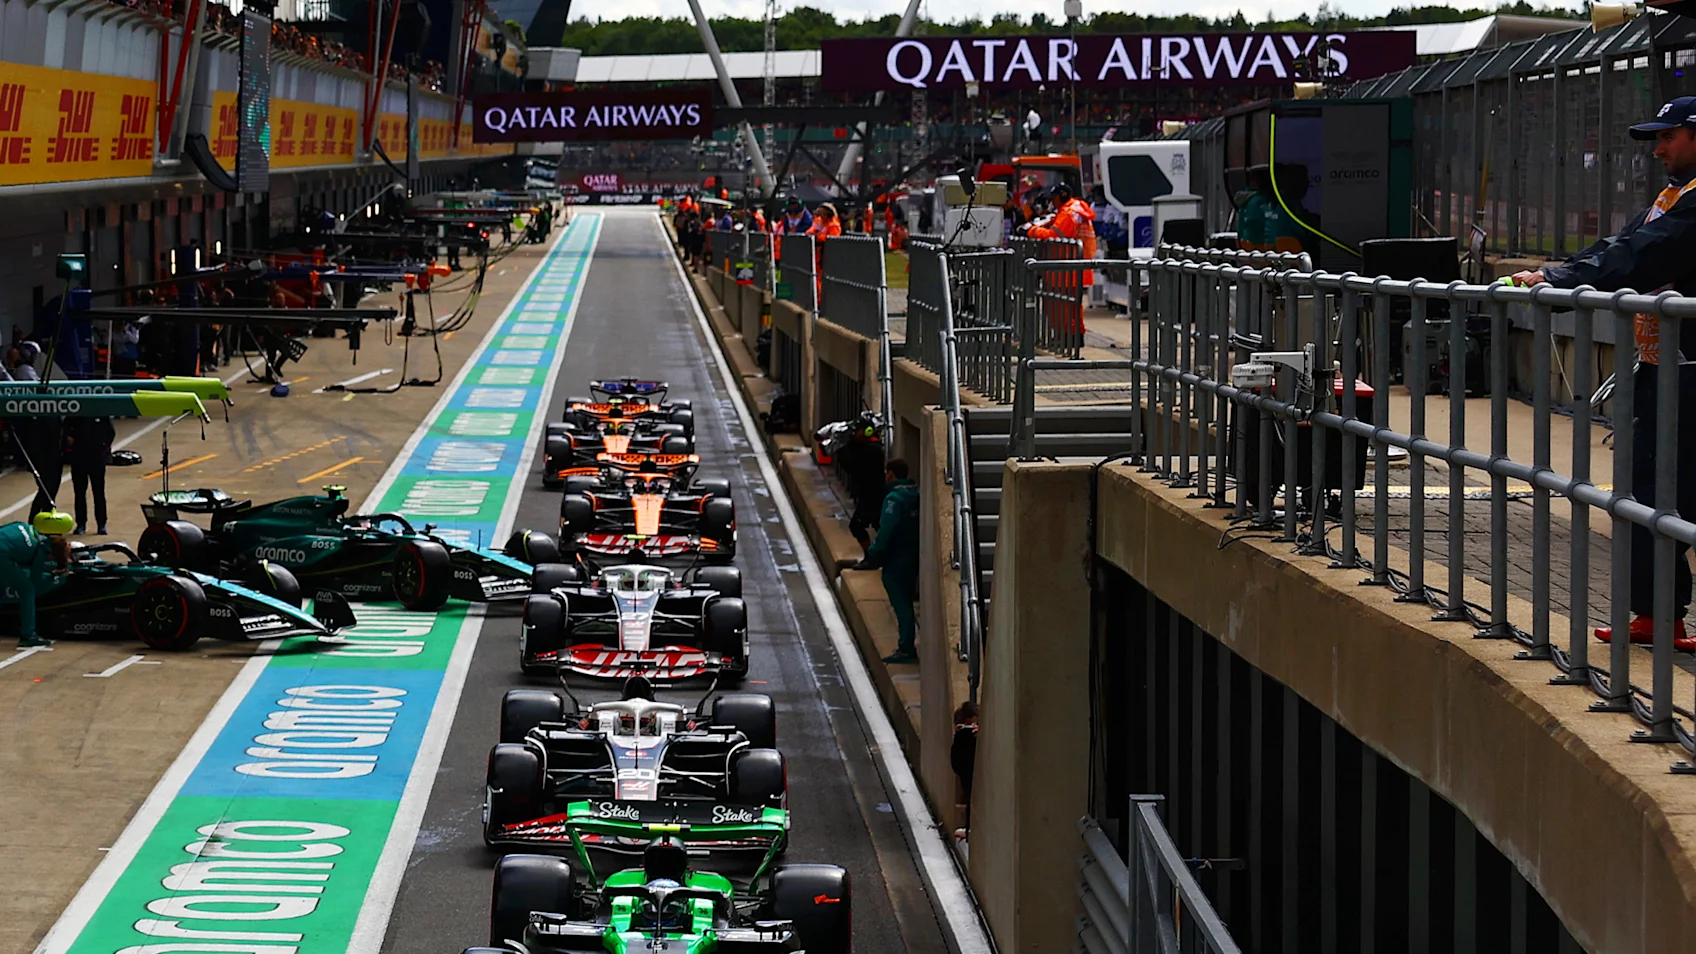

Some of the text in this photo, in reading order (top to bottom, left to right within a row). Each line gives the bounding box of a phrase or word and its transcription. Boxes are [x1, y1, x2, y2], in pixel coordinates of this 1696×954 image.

[886, 35, 1348, 88] QATAR AIRWAYS
[54, 89, 96, 161] DHL
[484, 103, 701, 133] QATAR AIRWAYS
[117, 94, 151, 160] DHL
[1330, 168, 1379, 180] aramco
[6, 400, 81, 413] aramco
[311, 541, 336, 550] BOSS
[255, 546, 306, 563] aramco
[454, 570, 473, 579] BOSS
[210, 608, 232, 618] BOSS
[233, 684, 409, 779] aramco
[617, 768, 656, 780] 20
[599, 802, 753, 824] Stake Stake
